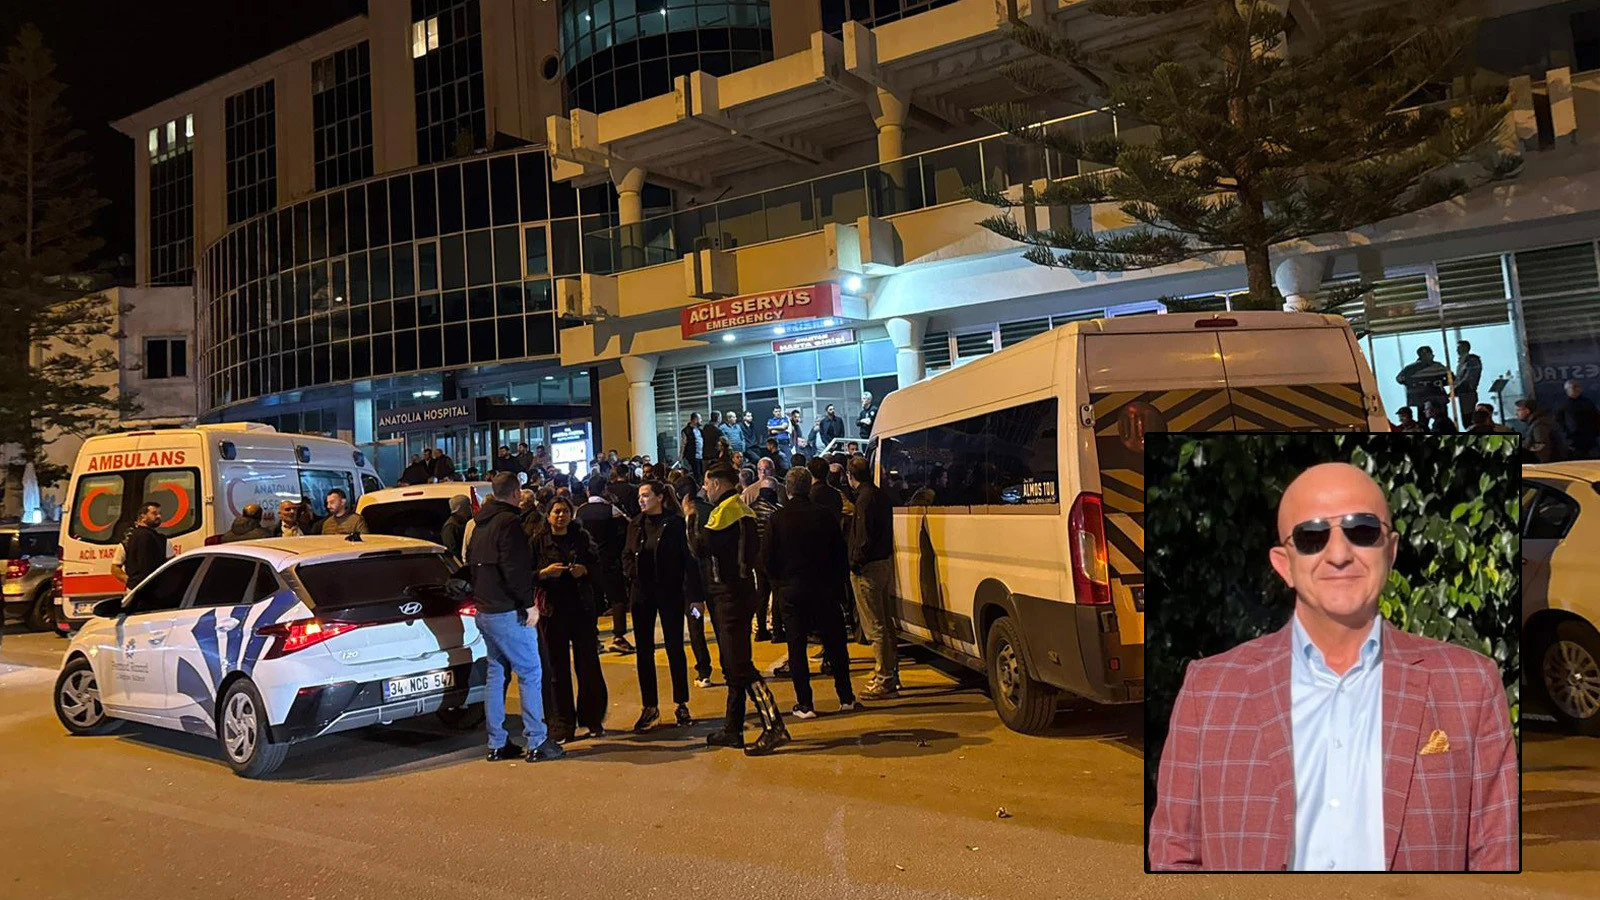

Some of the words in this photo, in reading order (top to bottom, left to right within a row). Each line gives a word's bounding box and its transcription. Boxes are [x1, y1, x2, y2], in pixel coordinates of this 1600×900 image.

[690, 304, 726, 323] ACİL
[730, 291, 811, 314] SERVİS
[706, 310, 783, 330] EMERGENCY
[379, 411, 422, 426] ANATOLIA
[424, 405, 469, 421] HOSPITAL
[87, 451, 186, 471] AMBULANS
[254, 484, 297, 495] ANATOLIA
[390, 682, 404, 696] 34
[410, 677, 429, 691] NCG
[434, 672, 453, 688] 547
